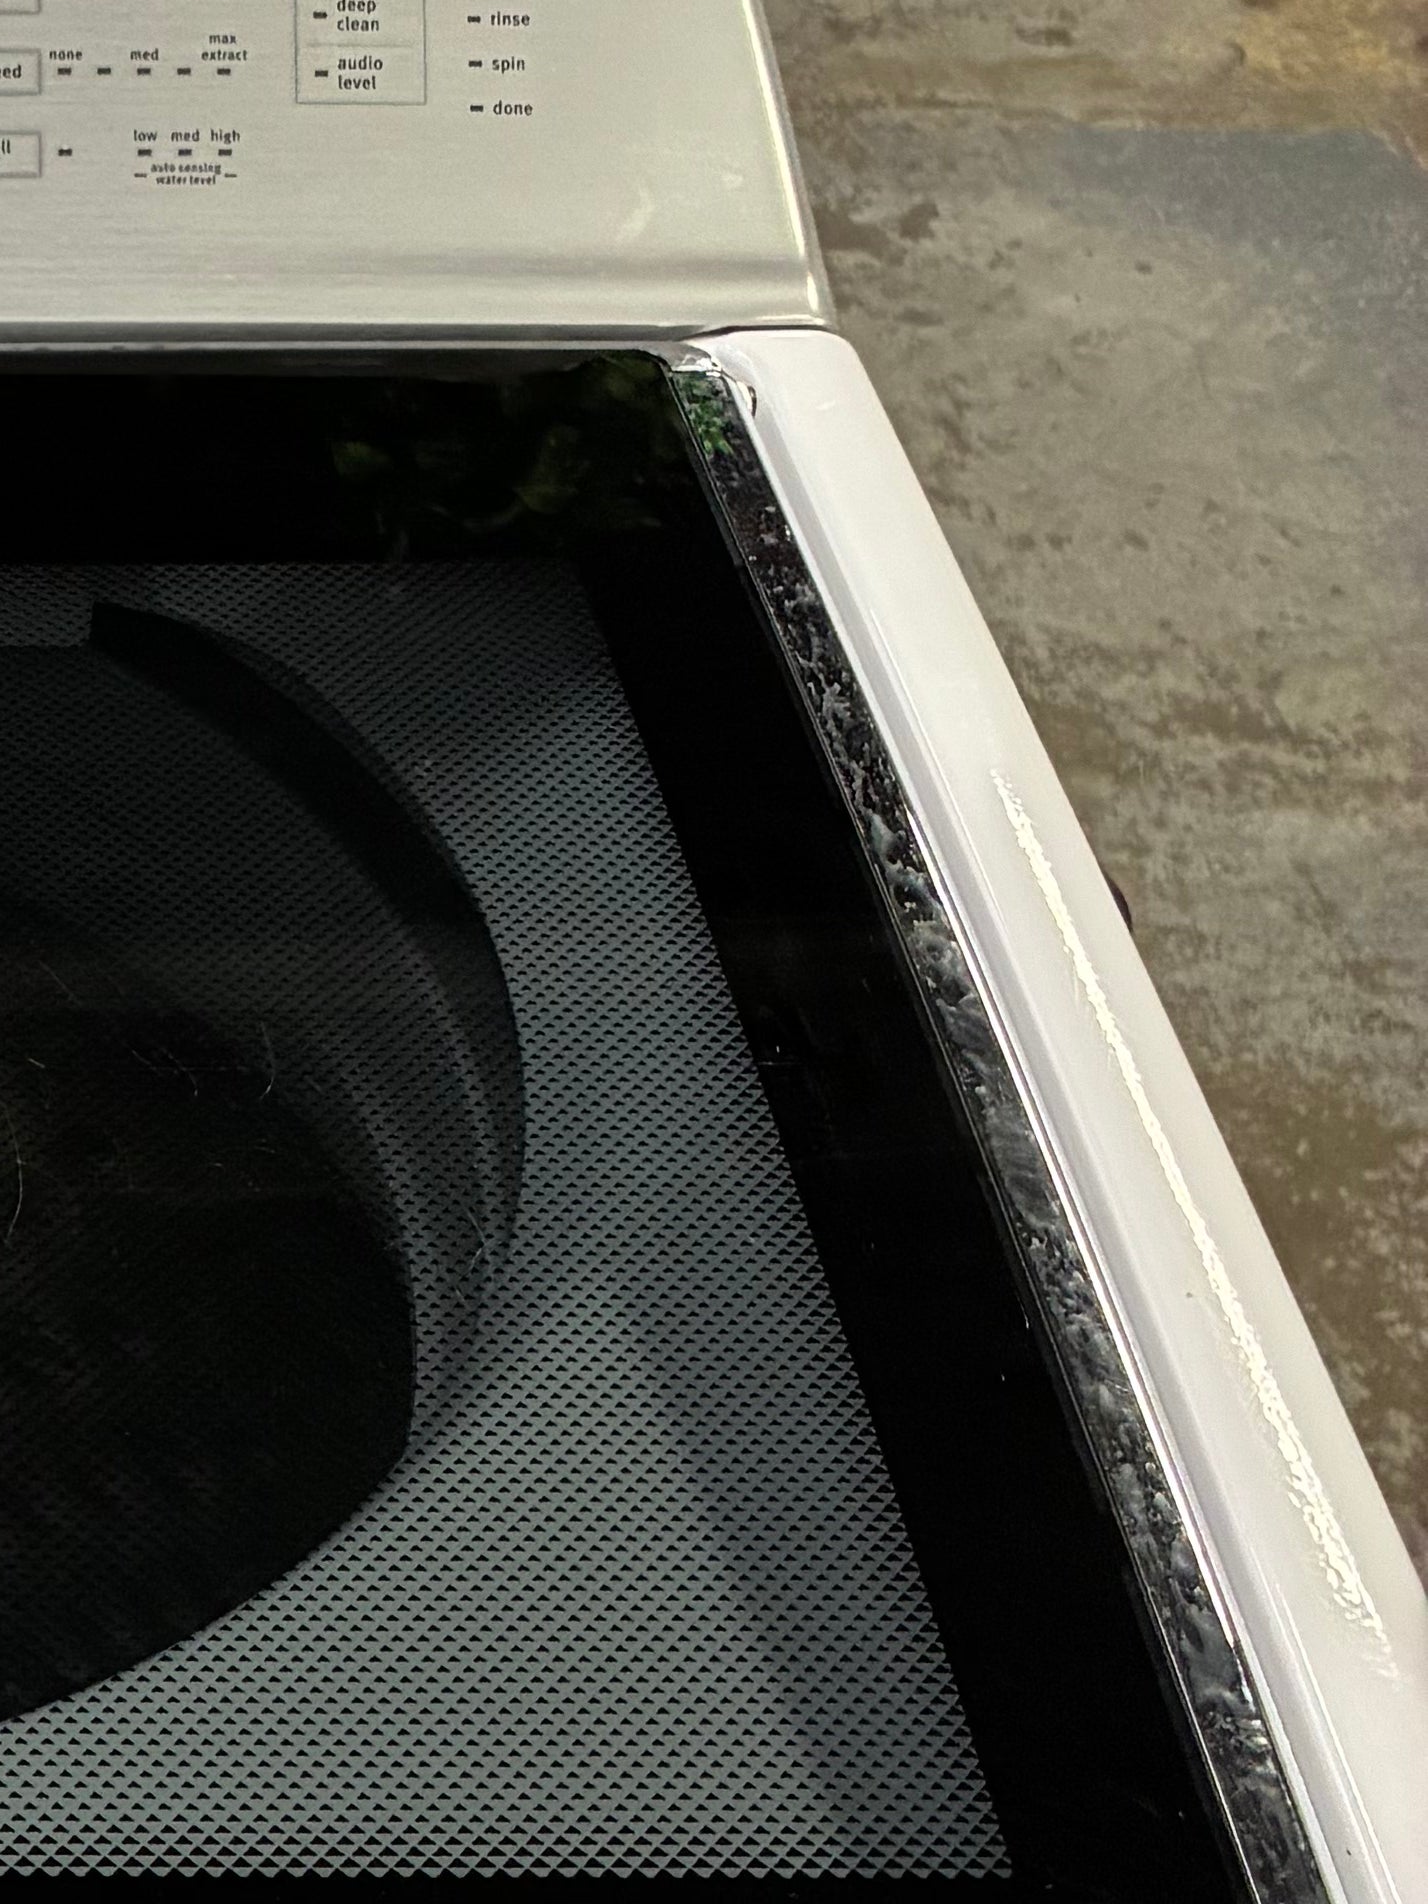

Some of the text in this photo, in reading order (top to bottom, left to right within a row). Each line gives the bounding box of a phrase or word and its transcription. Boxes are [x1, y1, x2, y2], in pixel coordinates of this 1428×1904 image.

[336, 14, 380, 33] clean
[490, 10, 531, 28] rinse
[209, 33, 237, 45] max
[49, 47, 248, 63] none med extract
[337, 55, 384, 73] audio
[491, 55, 526, 76] spin
[337, 73, 377, 92] level
[492, 99, 534, 117] done
[133, 128, 241, 144] low med high
